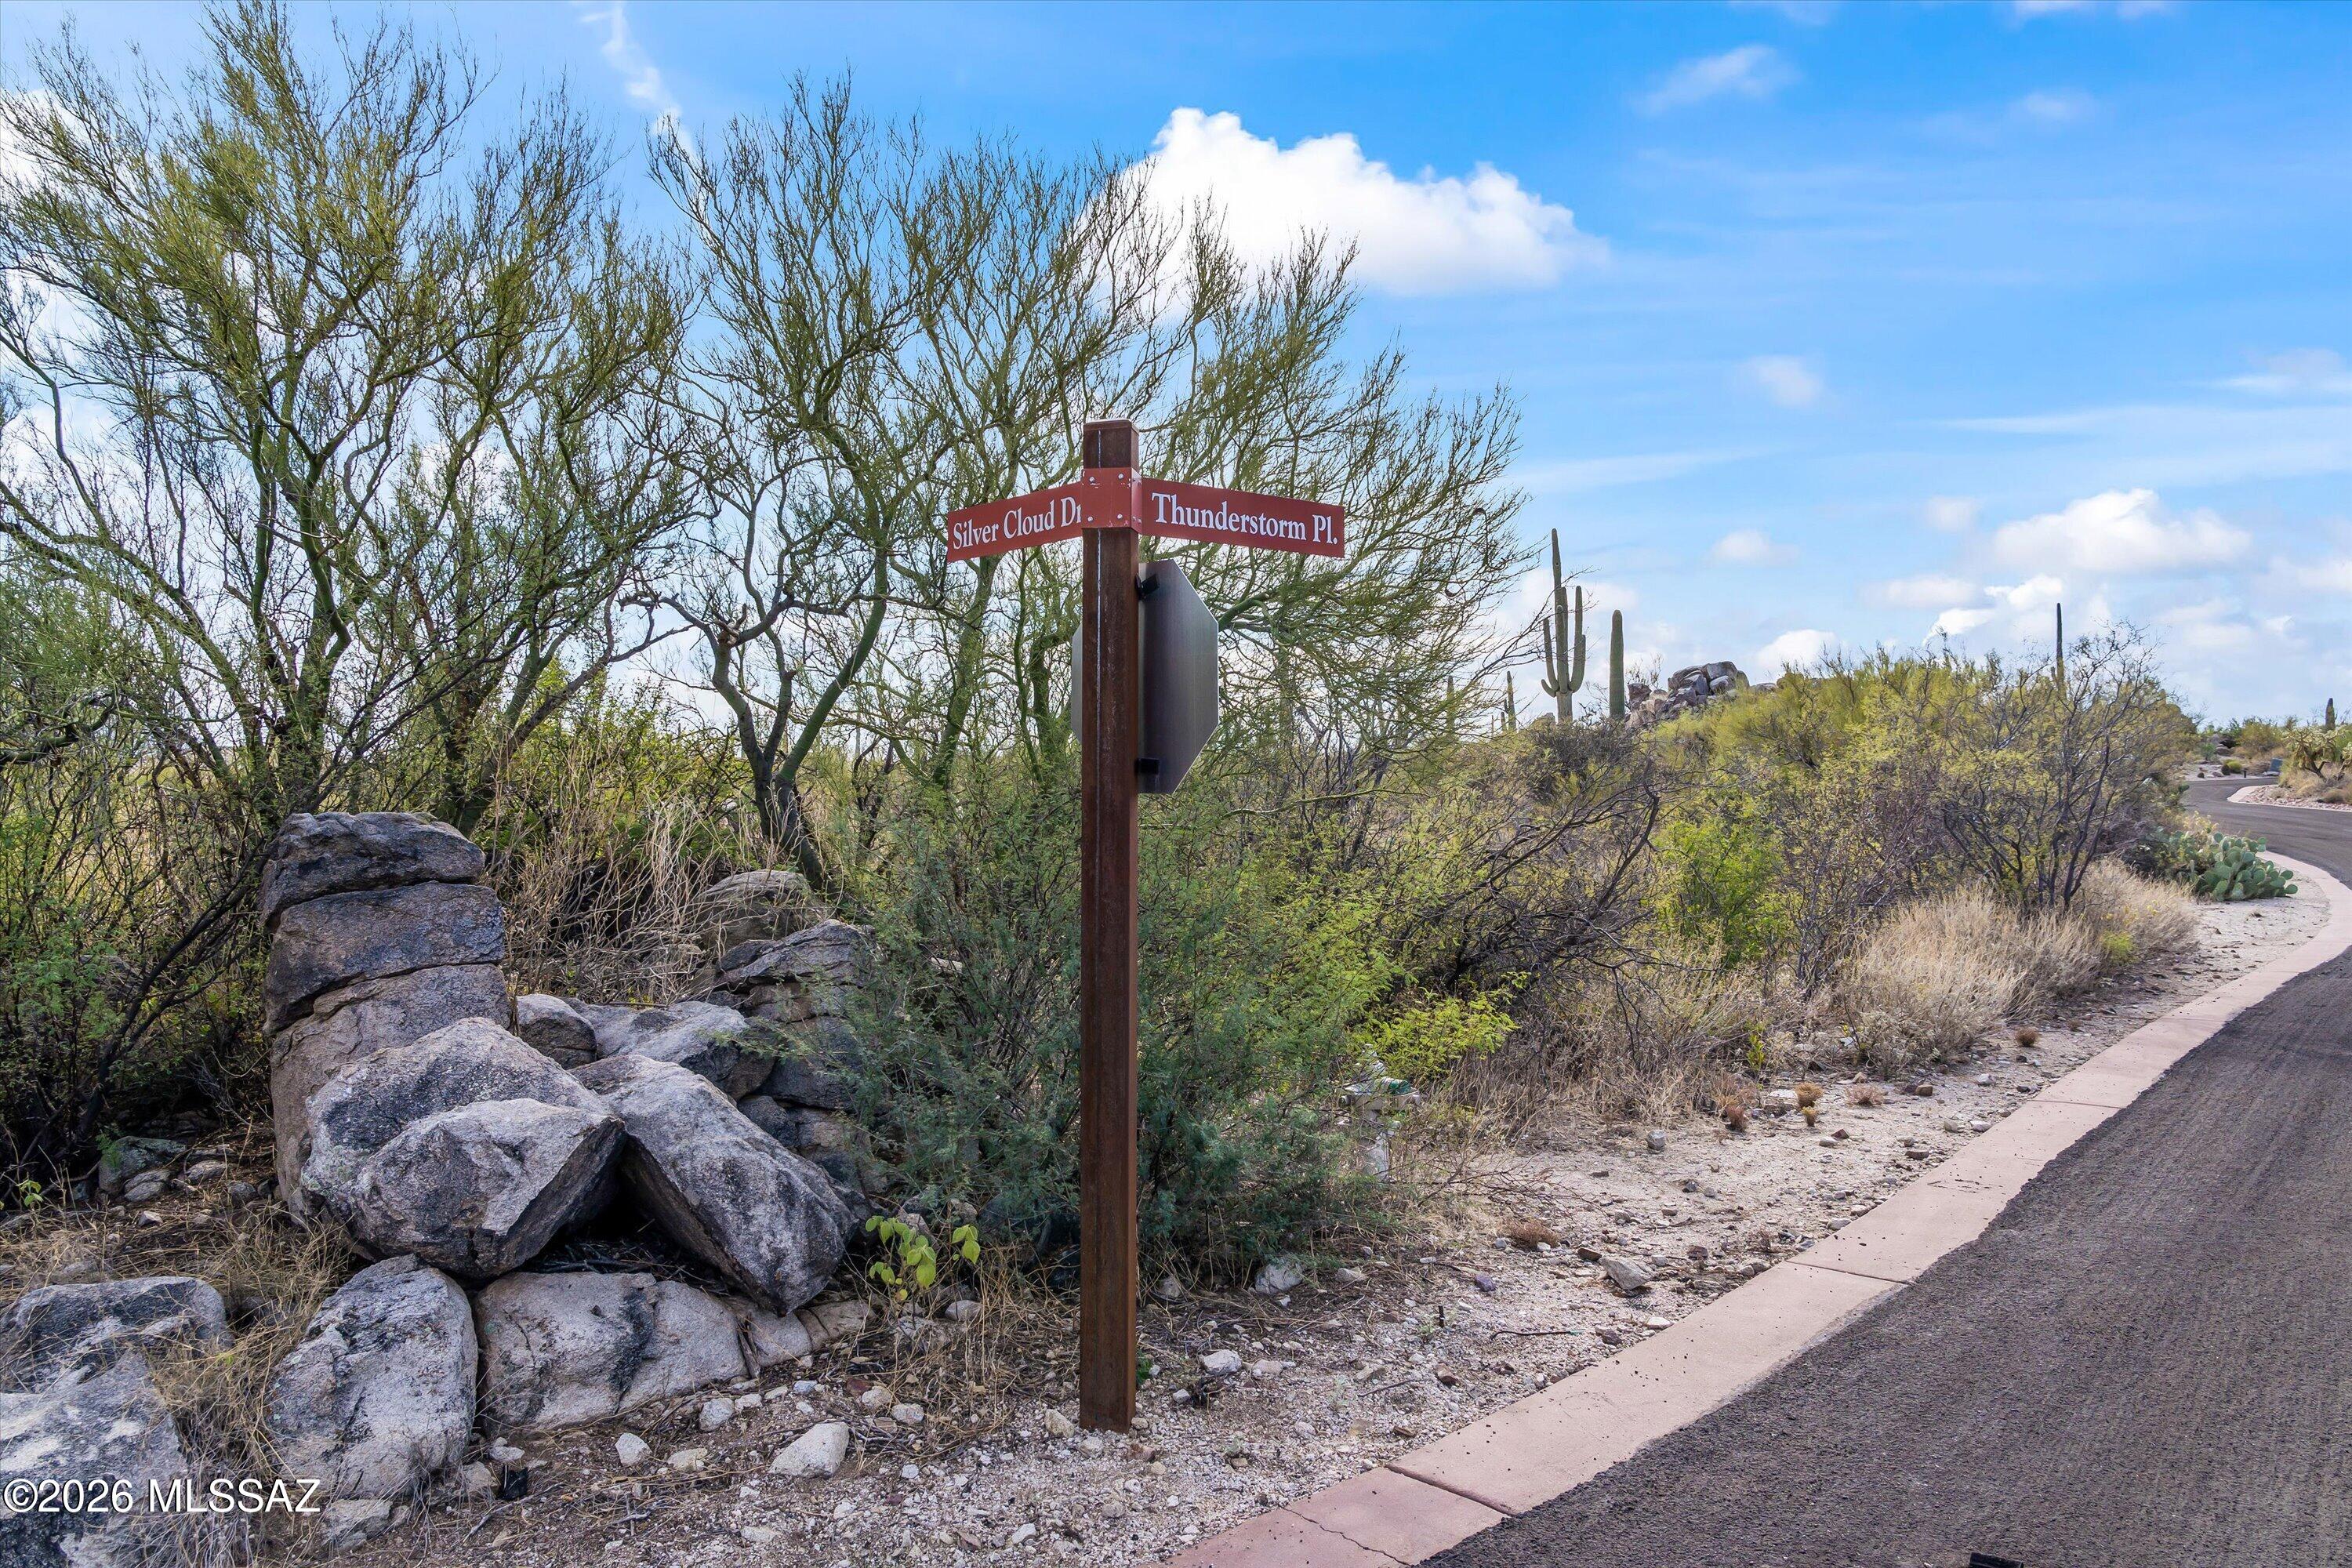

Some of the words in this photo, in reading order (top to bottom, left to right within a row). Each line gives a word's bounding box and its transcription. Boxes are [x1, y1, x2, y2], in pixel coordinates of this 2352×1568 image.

[953, 518, 1000, 550] Silver
[1004, 499, 1055, 539] Cloud
[1152, 492, 1307, 541] Thunderstorm
[1312, 514, 1338, 545] Pl.
